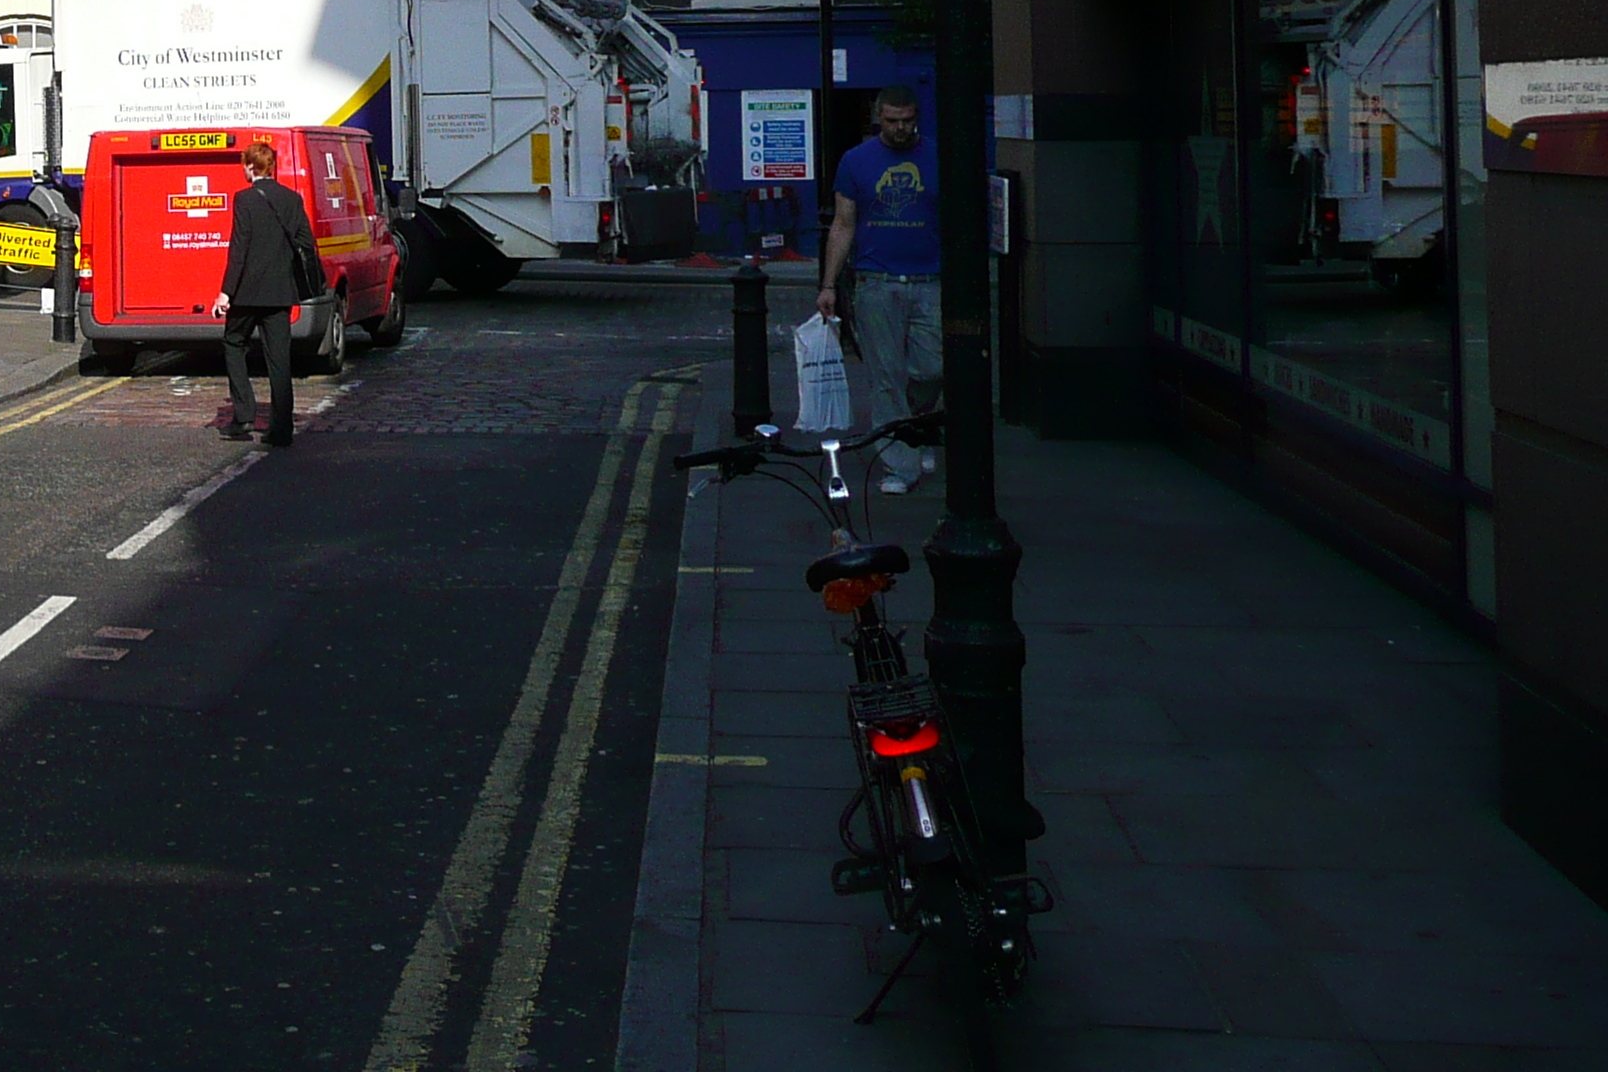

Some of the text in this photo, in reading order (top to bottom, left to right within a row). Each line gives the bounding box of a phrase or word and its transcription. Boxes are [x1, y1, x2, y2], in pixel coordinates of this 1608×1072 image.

[118, 45, 284, 69] City of Westminster
[143, 74, 257, 89] CLEAN STREETS
[119, 100, 285, 113] Environment Action Line 020 7641 2000
[114, 114, 164, 123] Commercial
[167, 113, 192, 122] Waste
[193, 112, 231, 124] Helpline
[233, 112, 248, 121] 020
[250, 111, 269, 121] 7641
[166, 134, 222, 147] LC55 GMF
[253, 133, 273, 143] L43
[172, 196, 223, 209] Royal Mail
